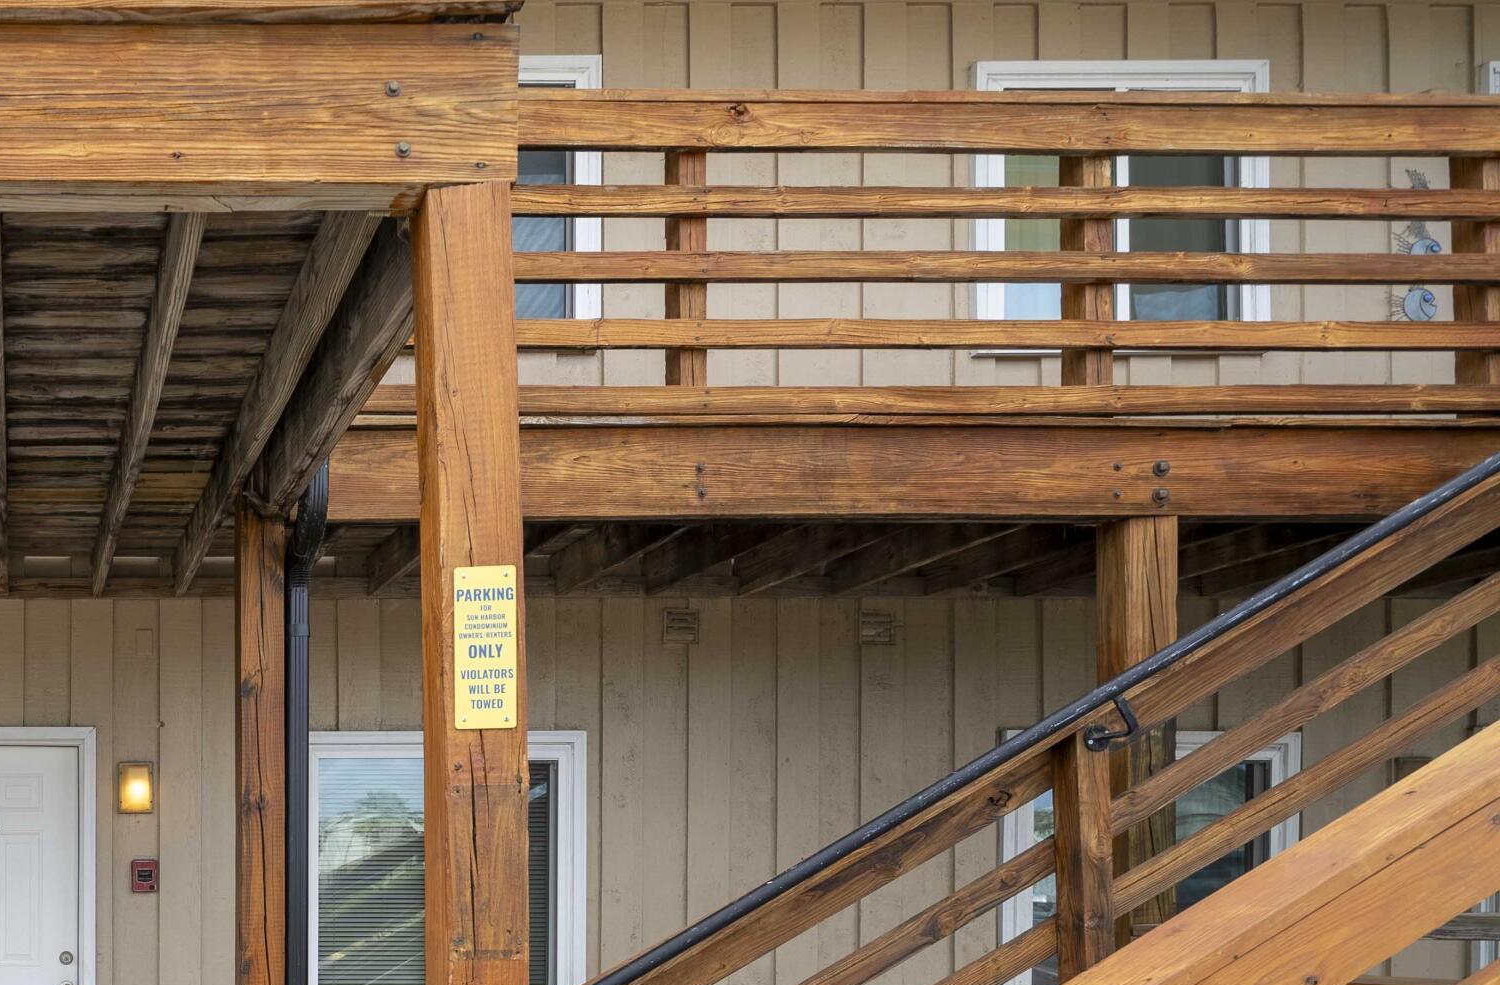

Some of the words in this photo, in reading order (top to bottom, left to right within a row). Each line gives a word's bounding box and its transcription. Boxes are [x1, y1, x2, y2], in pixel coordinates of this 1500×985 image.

[456, 587, 514, 602] PARKING
[464, 622, 508, 630] CONDOMINIUM
[468, 643, 503, 659] ONLY
[460, 668, 514, 680] VIOLATORS
[468, 684, 490, 694] WILL
[494, 683, 506, 694] BE
[471, 699, 503, 710] TOWED
